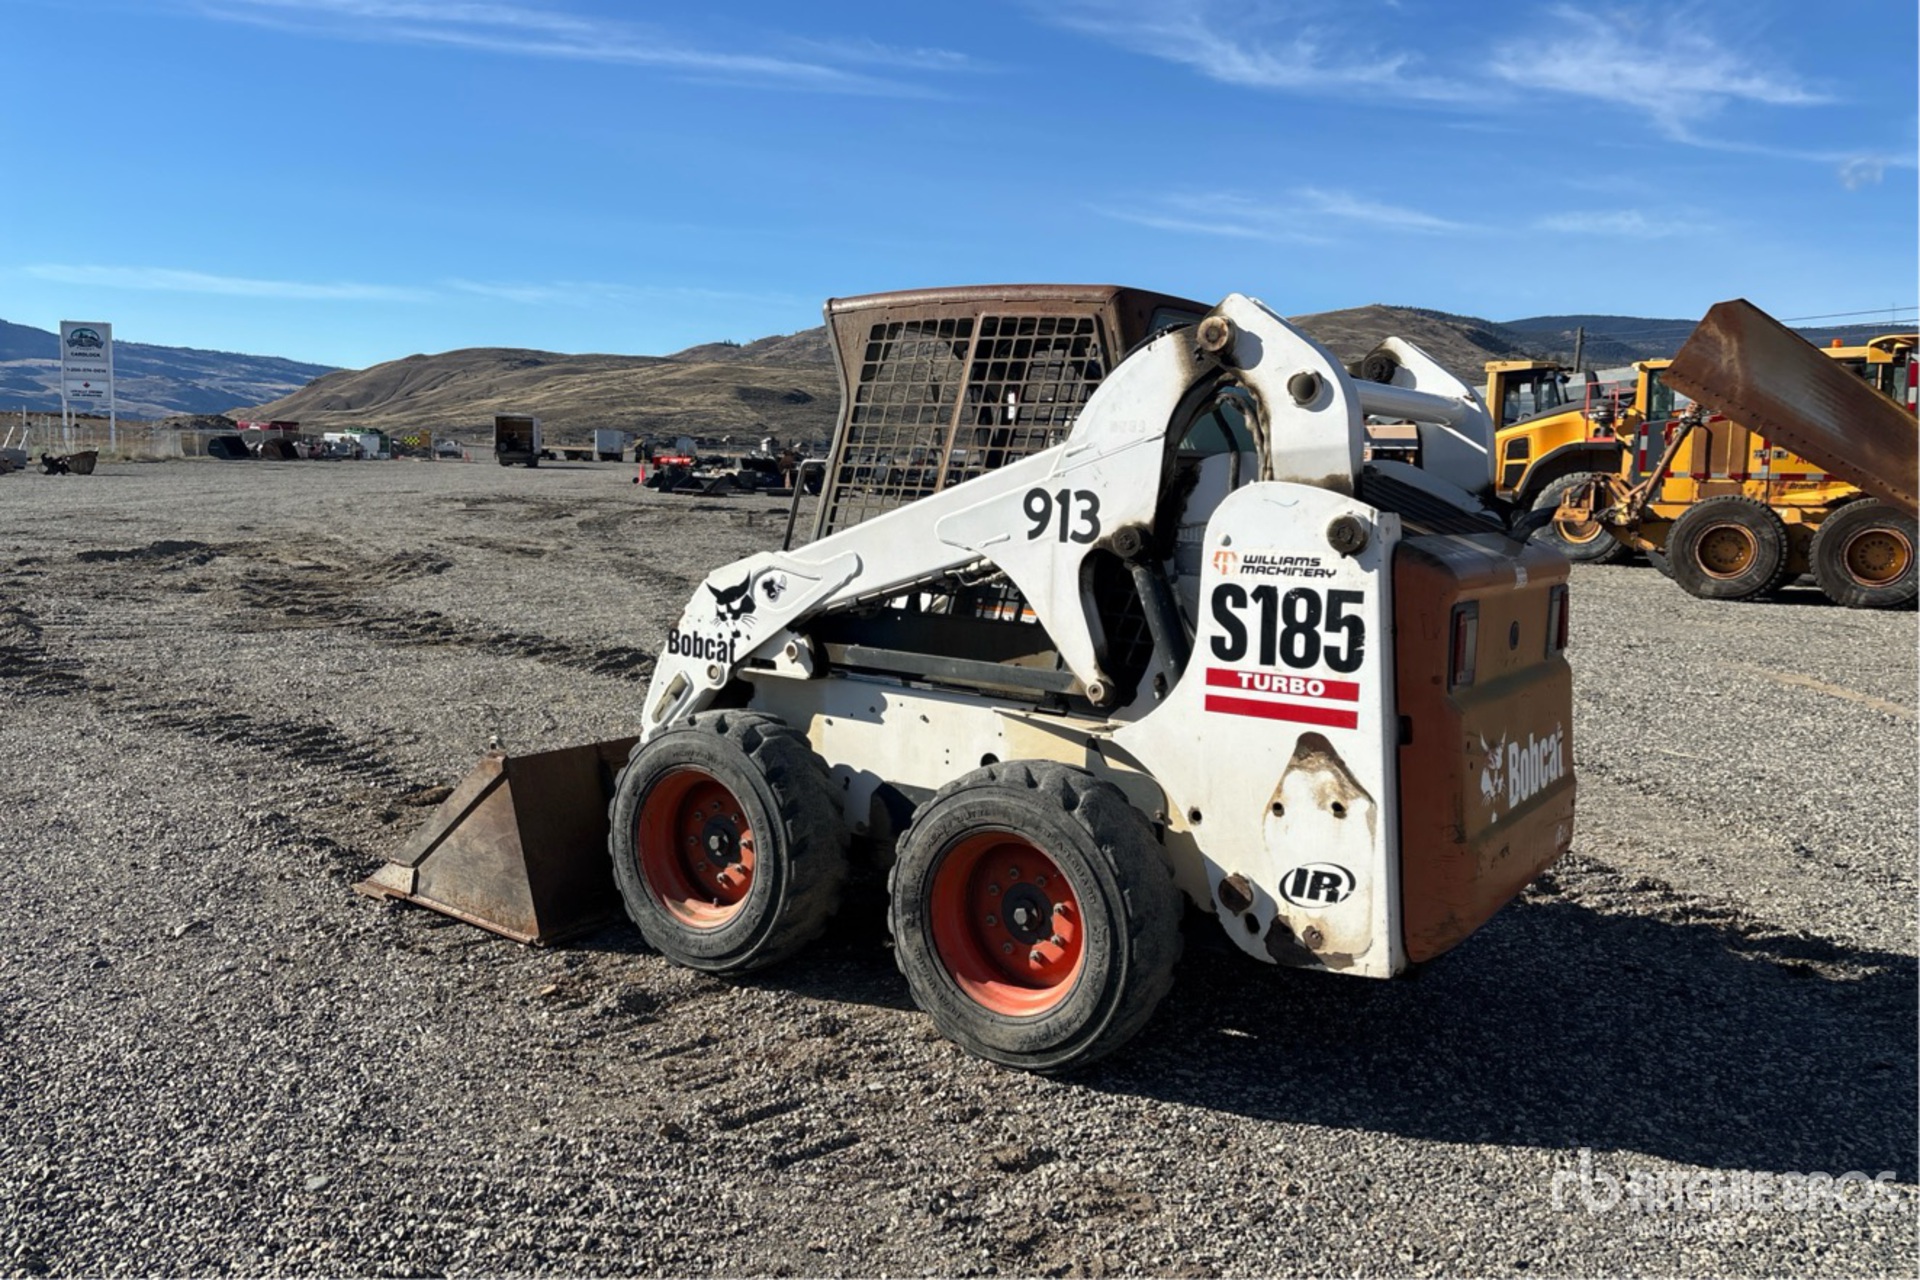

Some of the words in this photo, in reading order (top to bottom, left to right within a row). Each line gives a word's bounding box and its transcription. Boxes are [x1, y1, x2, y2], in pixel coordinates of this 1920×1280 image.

[1023, 487, 1101, 544] 913
[1240, 565, 1337, 579] MACHINERY
[1243, 555, 1321, 567] WILLIAMS
[668, 628, 736, 665] Bobcat
[1210, 583, 1366, 673] S185
[1238, 672, 1325, 696] TURBO
[1508, 721, 1564, 809] Bobcat
[1291, 867, 1343, 904] IR
